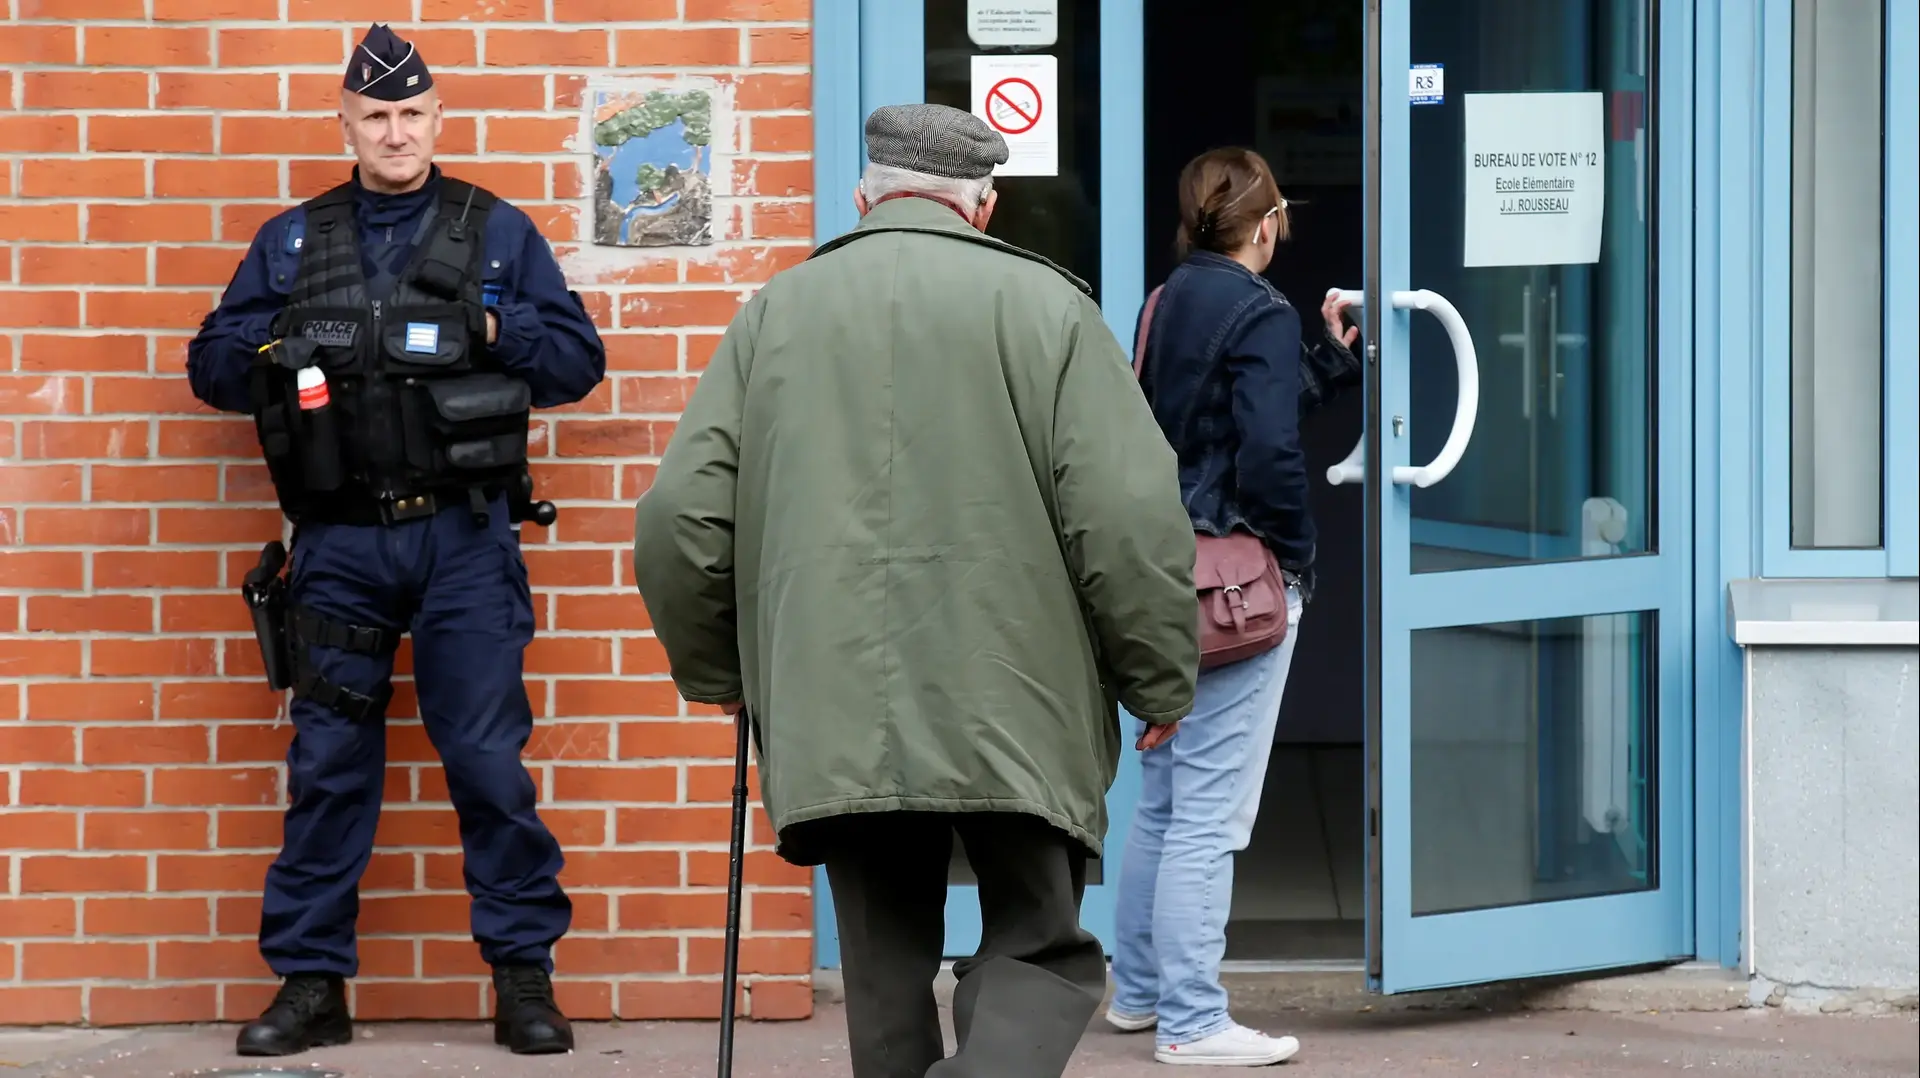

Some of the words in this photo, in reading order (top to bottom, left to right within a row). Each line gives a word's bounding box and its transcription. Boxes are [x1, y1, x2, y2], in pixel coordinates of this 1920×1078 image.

[1474, 153, 1519, 168] BUREAU
[1522, 152, 1536, 167] DE
[1538, 152, 1567, 167] VOTE
[1570, 151, 1582, 166] N°
[1585, 152, 1597, 166] 12
[1495, 177, 1520, 190] Ecole
[1522, 175, 1575, 190] Elémentaire
[1500, 199, 1516, 212] J.J.
[1518, 197, 1569, 211] ROUSSEAU
[304, 321, 355, 333] POLICE
